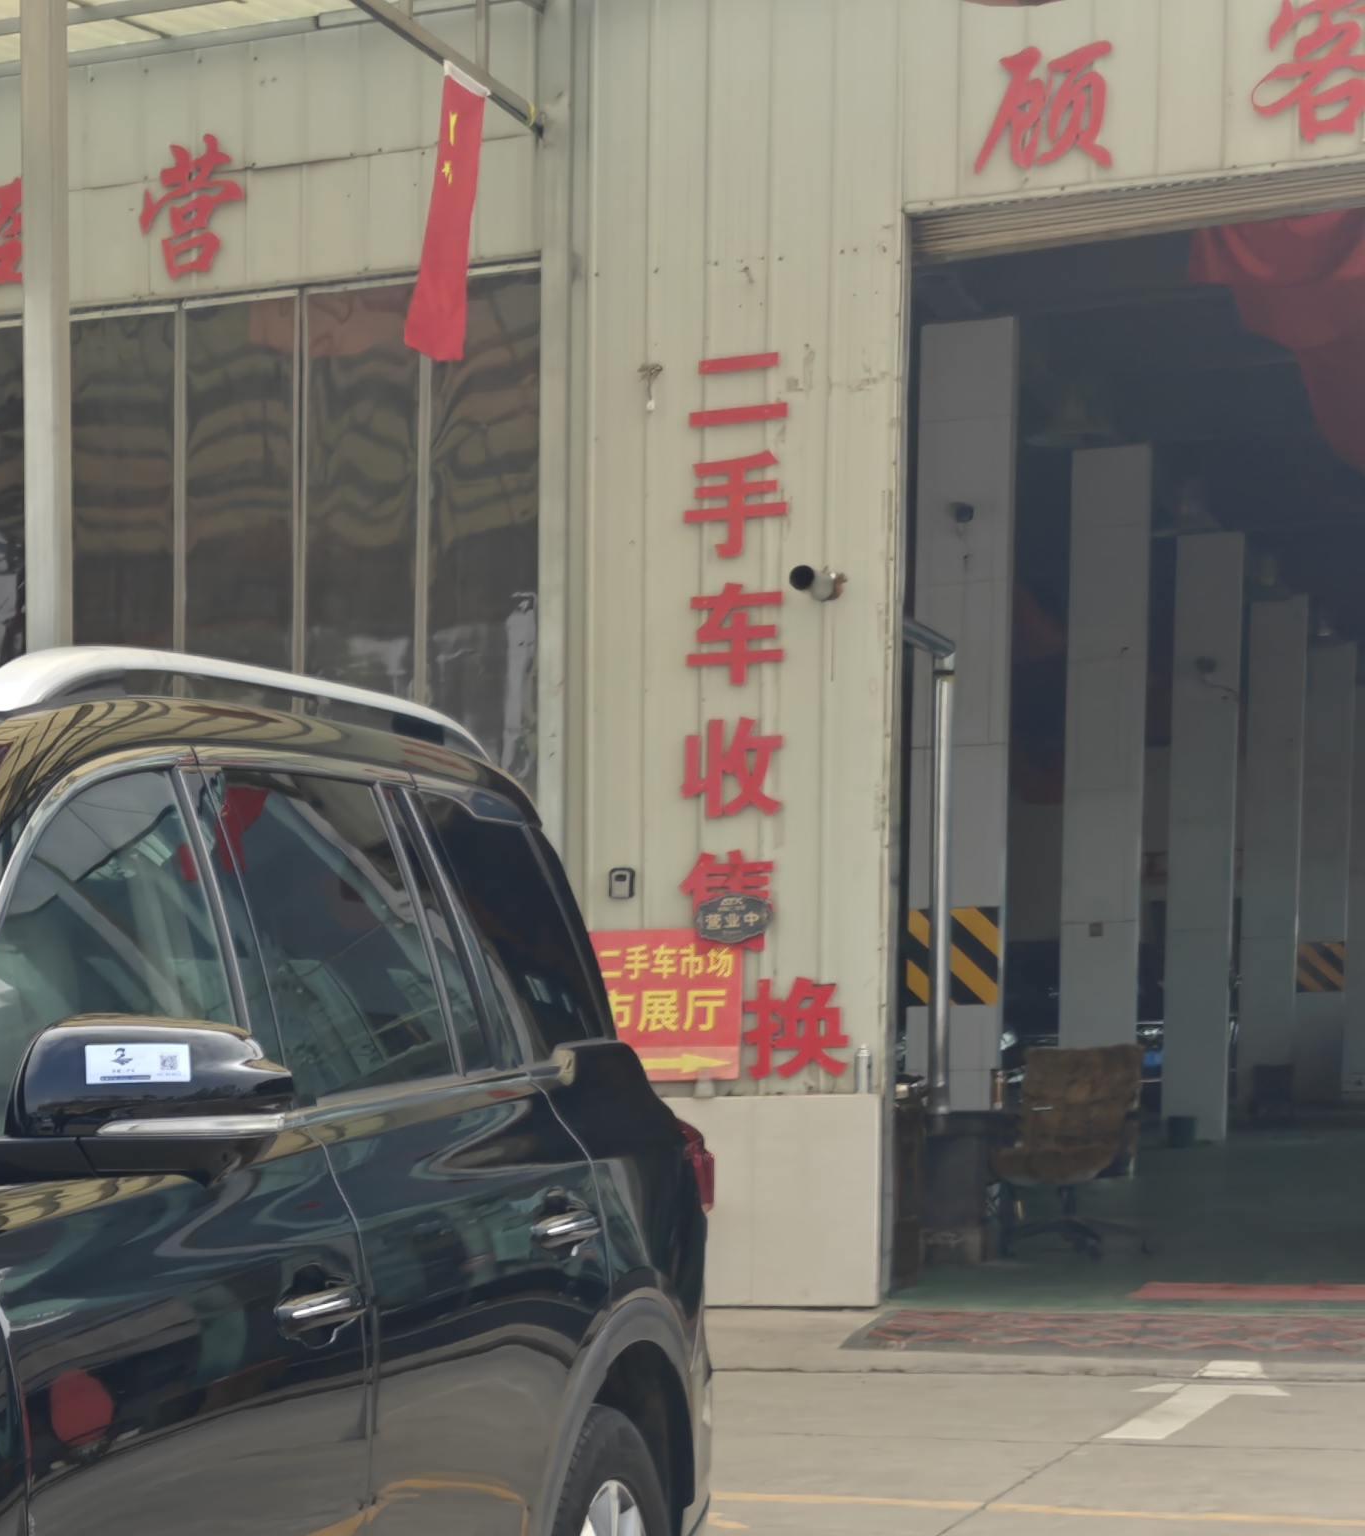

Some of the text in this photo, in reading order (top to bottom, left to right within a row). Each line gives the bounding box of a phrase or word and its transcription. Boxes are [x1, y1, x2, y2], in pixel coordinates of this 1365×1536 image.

[599, 943, 734, 980] 二手车市场
